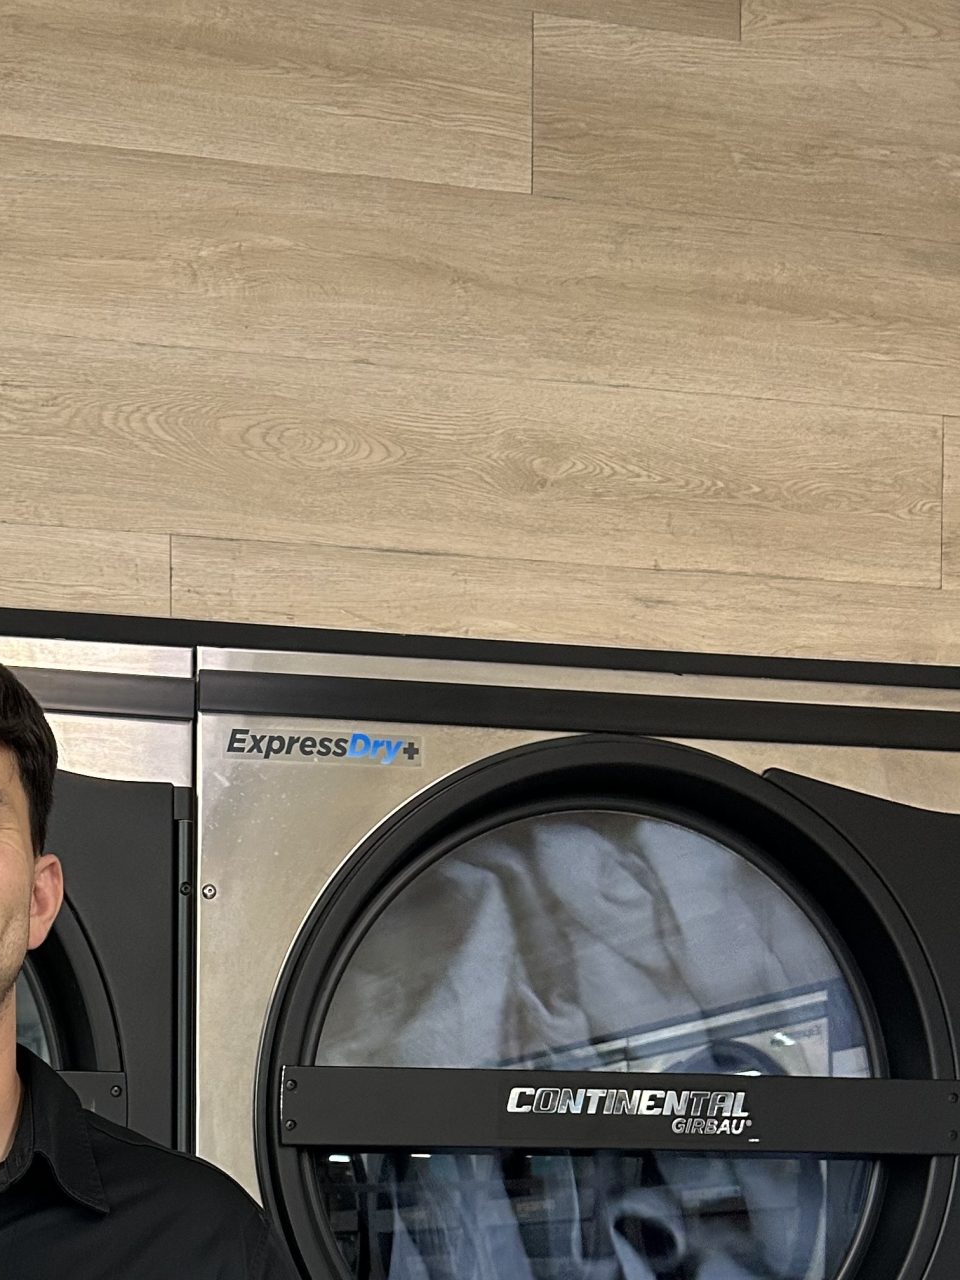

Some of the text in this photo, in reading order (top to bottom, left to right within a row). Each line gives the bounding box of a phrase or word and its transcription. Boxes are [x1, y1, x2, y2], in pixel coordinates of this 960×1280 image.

[227, 728, 419, 764] ExpressDry+
[506, 1087, 749, 1117] CONTINENTAL
[672, 1118, 745, 1134] GIRBAU
